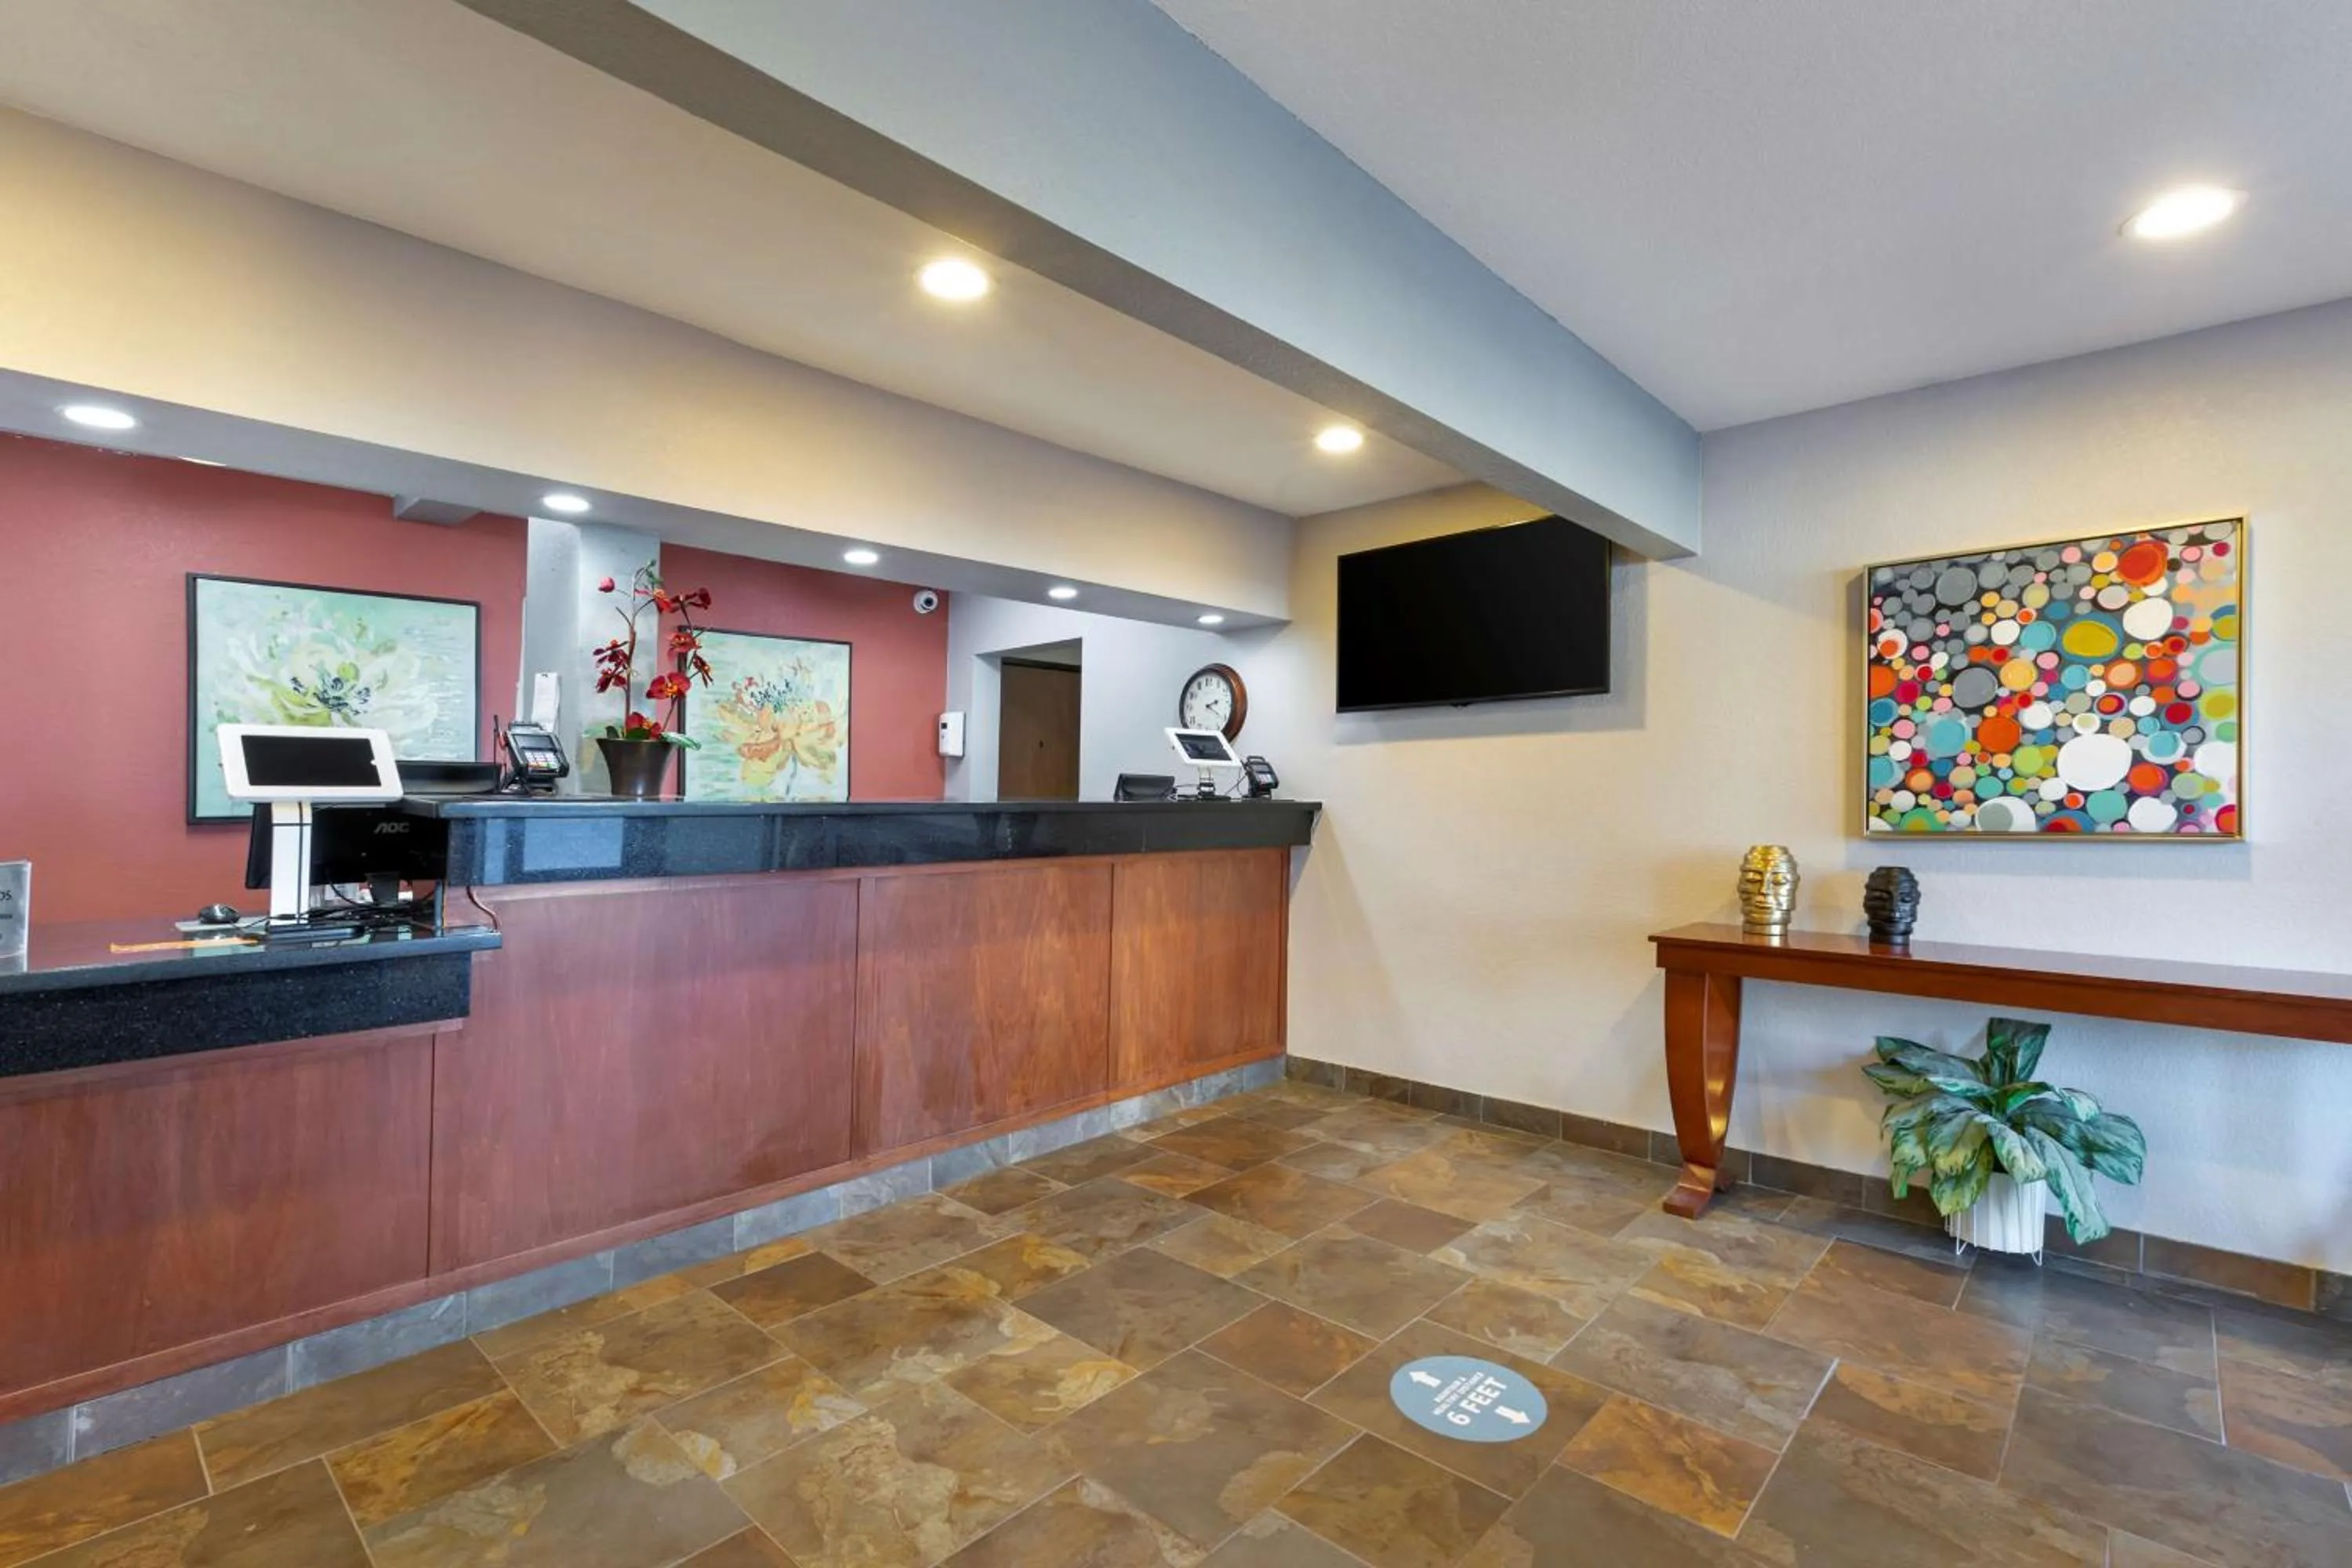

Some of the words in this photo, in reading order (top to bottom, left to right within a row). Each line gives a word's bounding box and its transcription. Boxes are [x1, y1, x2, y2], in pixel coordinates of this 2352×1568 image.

[373, 822, 410, 834] AOC
[1446, 1411, 1471, 1425] 6
[1460, 1376, 1507, 1414] FEET
